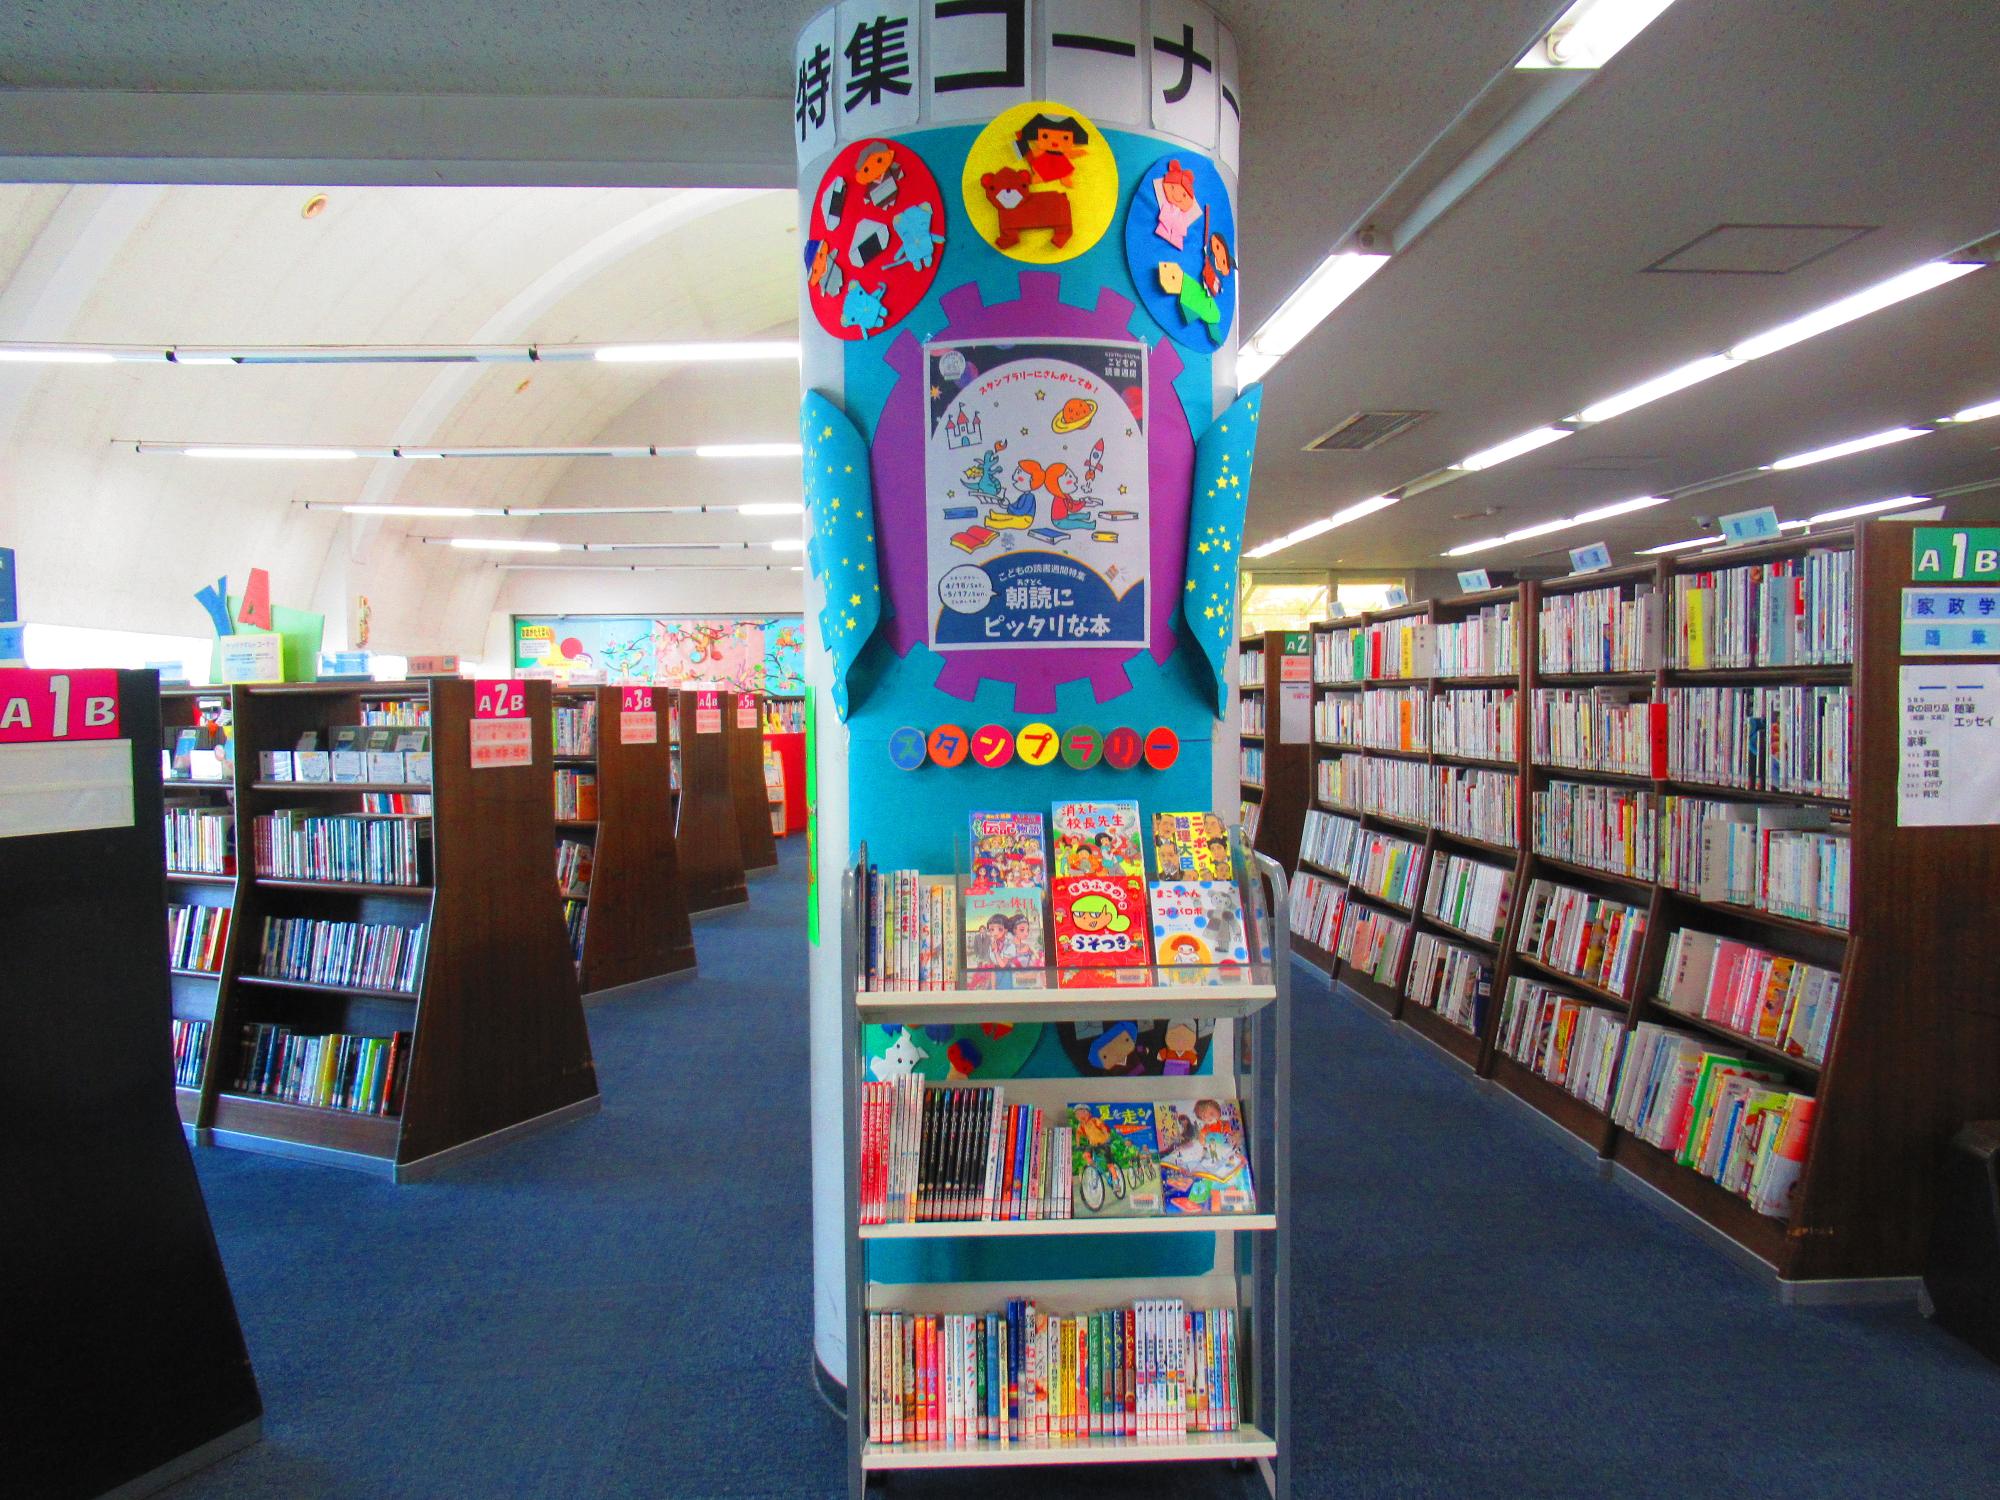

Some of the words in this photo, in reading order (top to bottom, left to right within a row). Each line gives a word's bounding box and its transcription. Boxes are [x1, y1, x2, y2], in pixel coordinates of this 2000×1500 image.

[998, 563, 1088, 583] こどもの読書週間特集
[1005, 586, 1075, 610] 朝読に
[1917, 596, 1996, 615] 家政学
[985, 613, 1112, 639] ピッタリな本
[1907, 703, 1949, 713] 身の回り品
[1954, 703, 1975, 714] 随筆
[1954, 716, 1993, 727] エッセイ
[896, 732, 1172, 764] スタンプラリー
[1061, 804, 1099, 817] 消えた
[1066, 813, 1125, 830] 校長先生
[1175, 815, 1195, 870] 総理大臣
[1075, 935, 1126, 950] うそつき
